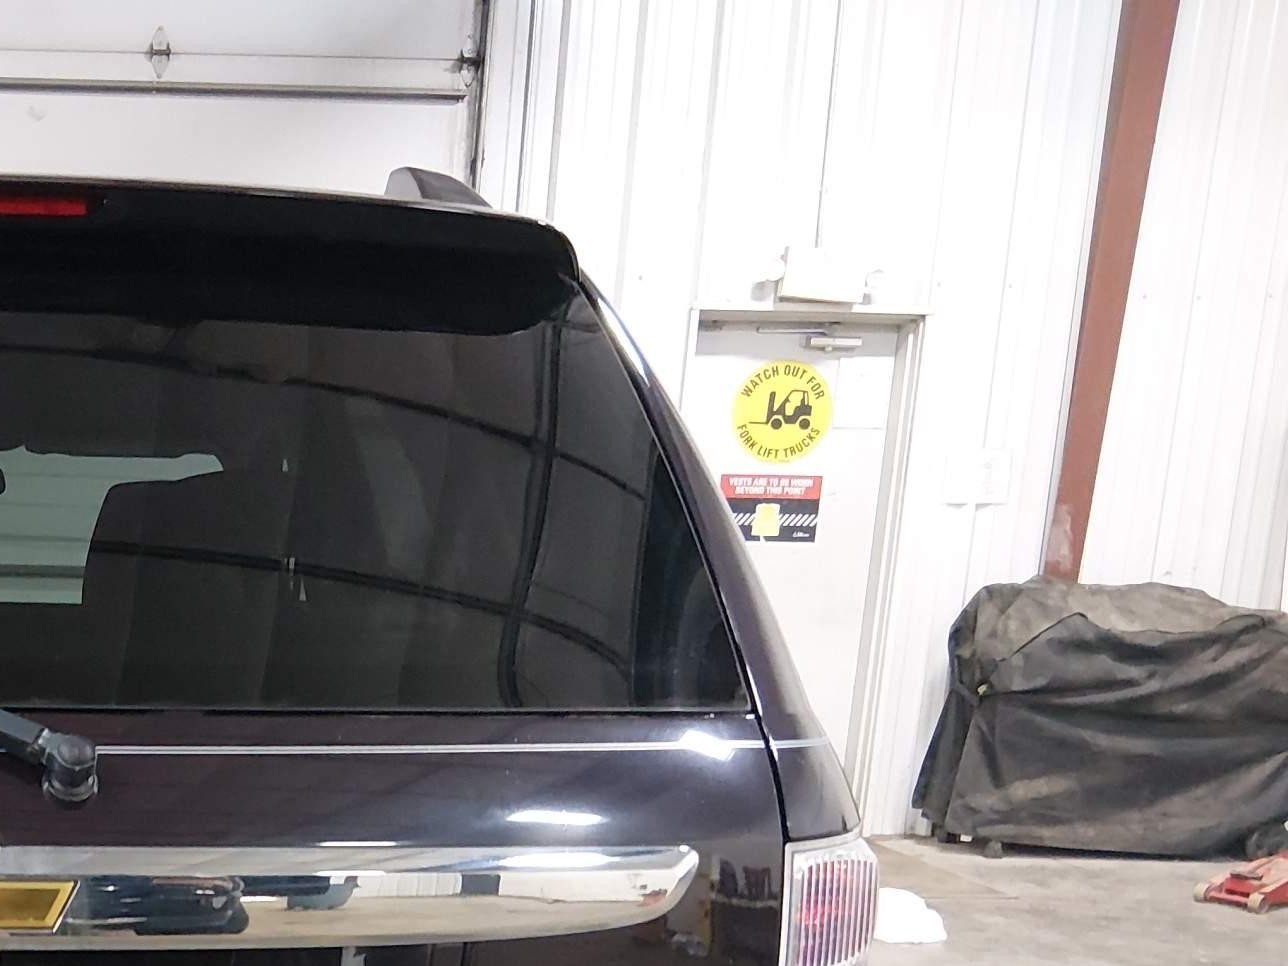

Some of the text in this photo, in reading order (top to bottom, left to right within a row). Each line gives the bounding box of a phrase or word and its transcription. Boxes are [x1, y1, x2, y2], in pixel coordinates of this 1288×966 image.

[741, 364, 825, 400] WATCH OUT FOR
[736, 423, 821, 459] FORK LIFT TRUCKS
[728, 477, 752, 487] VESTS
[753, 478, 768, 487] ARE
[769, 478, 779, 487] TO
[734, 486, 807, 496] BEYOND THIS POINT
